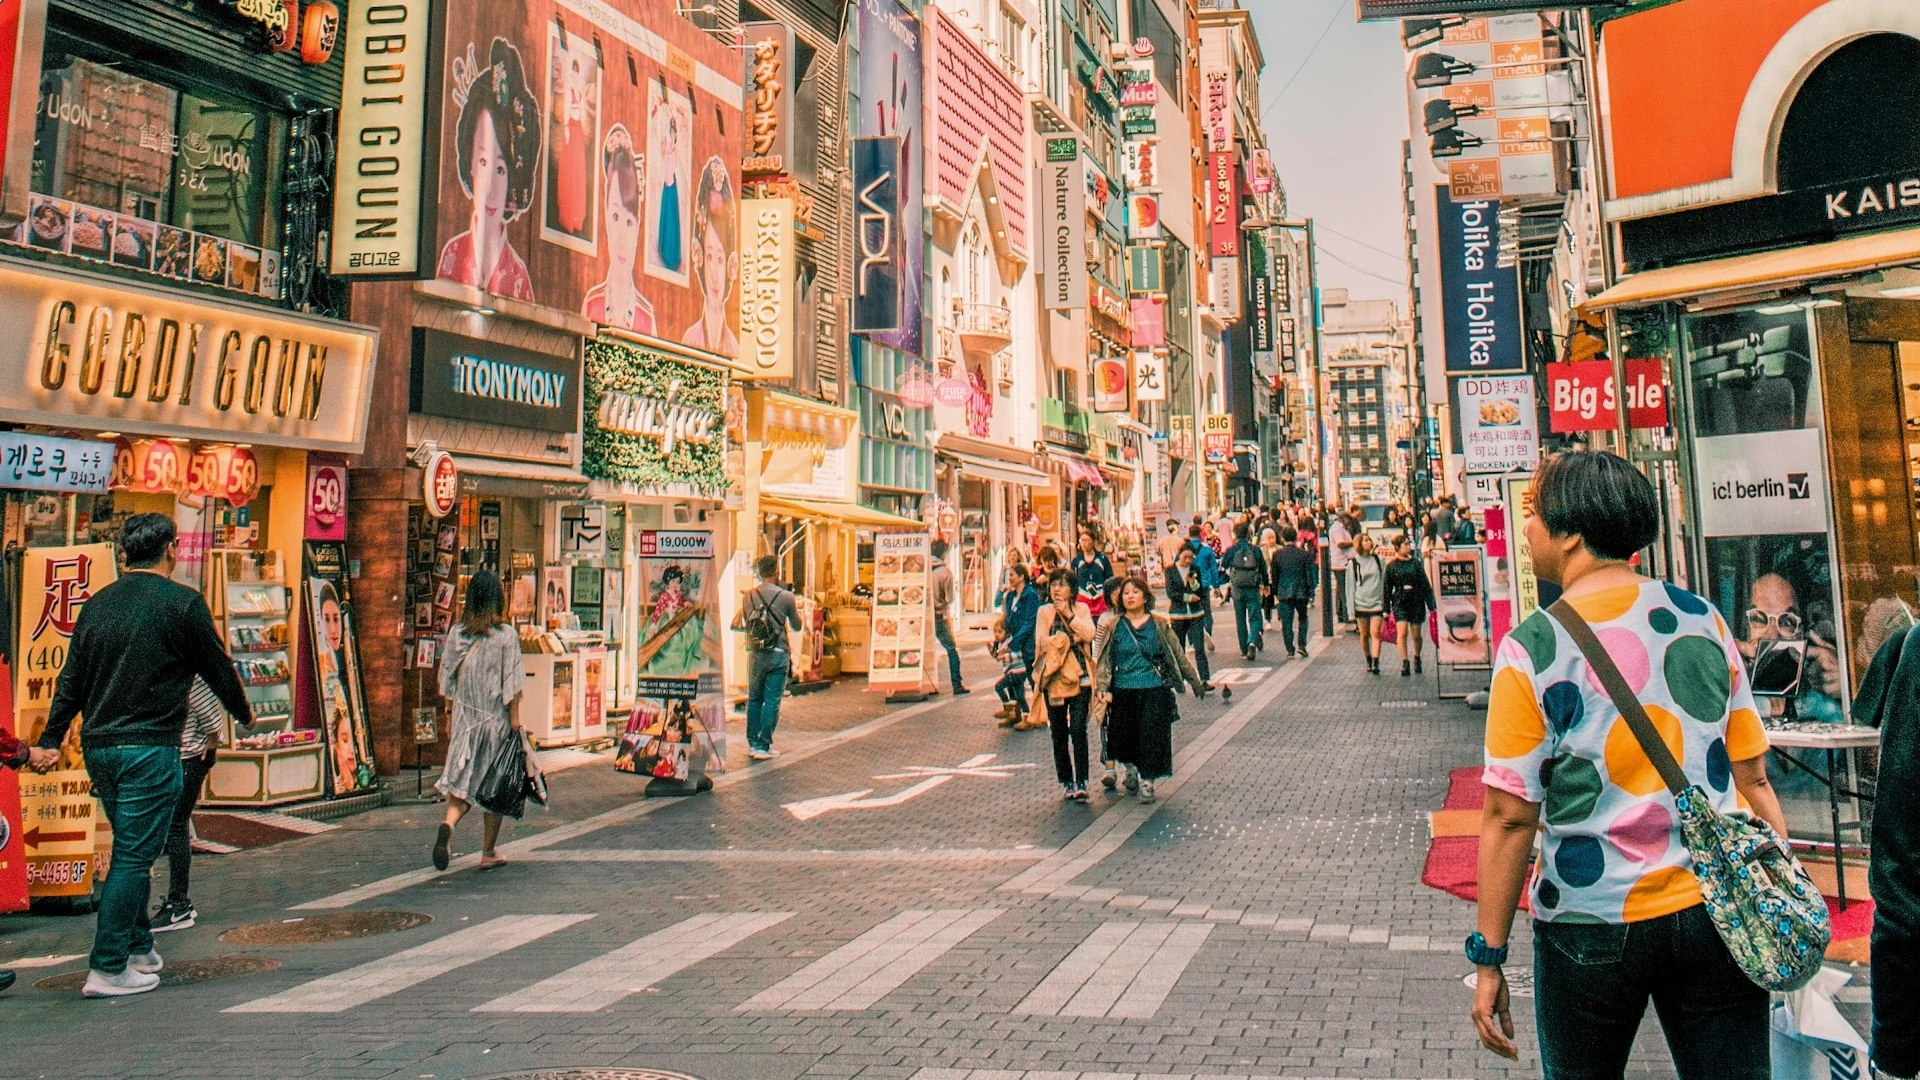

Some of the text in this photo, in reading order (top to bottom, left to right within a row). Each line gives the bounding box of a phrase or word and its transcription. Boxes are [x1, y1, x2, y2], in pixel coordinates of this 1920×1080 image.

[1121, 84, 1158, 103] Mud
[354, 4, 407, 240] OBDI GOUN
[1454, 171, 1496, 185] style
[1455, 181, 1497, 195] mall
[1215, 205, 1226, 225] 2
[1825, 178, 1920, 220] KAIS
[860, 170, 890, 297] VDL
[1056, 166, 1072, 303] Nature Collection
[1221, 241, 1234, 252] 3F
[349, 251, 401, 267] 곱디고운
[757, 209, 781, 369] SKINFOOD
[1256, 277, 1268, 350] HOLLYS COFFEE
[1466, 281, 1497, 366] Holika
[40, 299, 328, 421] GOBDI GOUN
[1138, 364, 1160, 390] 光
[463, 356, 565, 408] TONYMOLY
[1466, 380, 1493, 396] DD
[1554, 374, 1662, 420] Big Sale
[881, 402, 910, 439] VDL
[1208, 417, 1229, 429] BIG
[80, 451, 102, 469] 우동
[1207, 435, 1230, 448] MART
[7, 444, 67, 483] 겐로쿠
[146, 451, 178, 489] 50
[190, 455, 219, 493] 50
[228, 457, 257, 494] 50
[314, 477, 340, 514] 50
[1712, 478, 1784, 500] ic! berlin
[26, 860, 87, 885] 5-4455 3F
